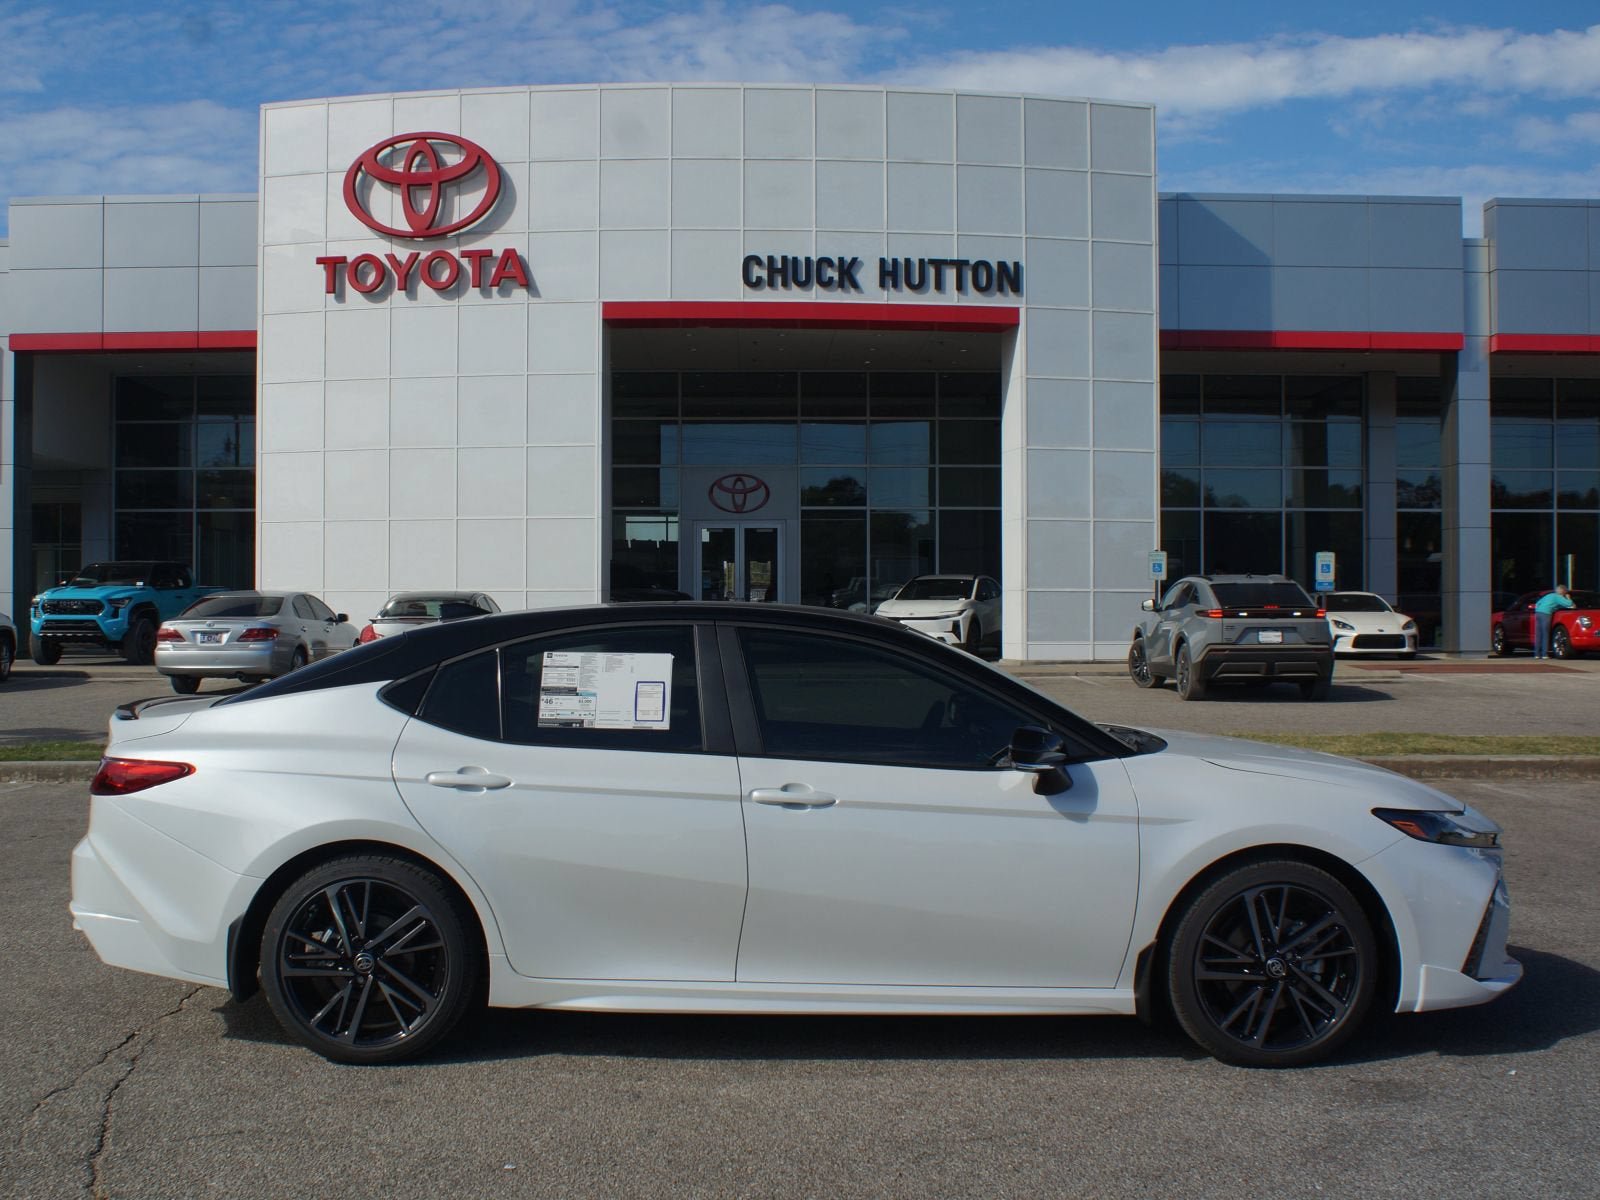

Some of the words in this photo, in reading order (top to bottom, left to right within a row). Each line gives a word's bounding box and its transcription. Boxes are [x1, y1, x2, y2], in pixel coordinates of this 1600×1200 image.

[316, 248, 529, 294] TOYOTA
[742, 254, 860, 289] CHUCK
[878, 257, 1021, 293] HUTTON
